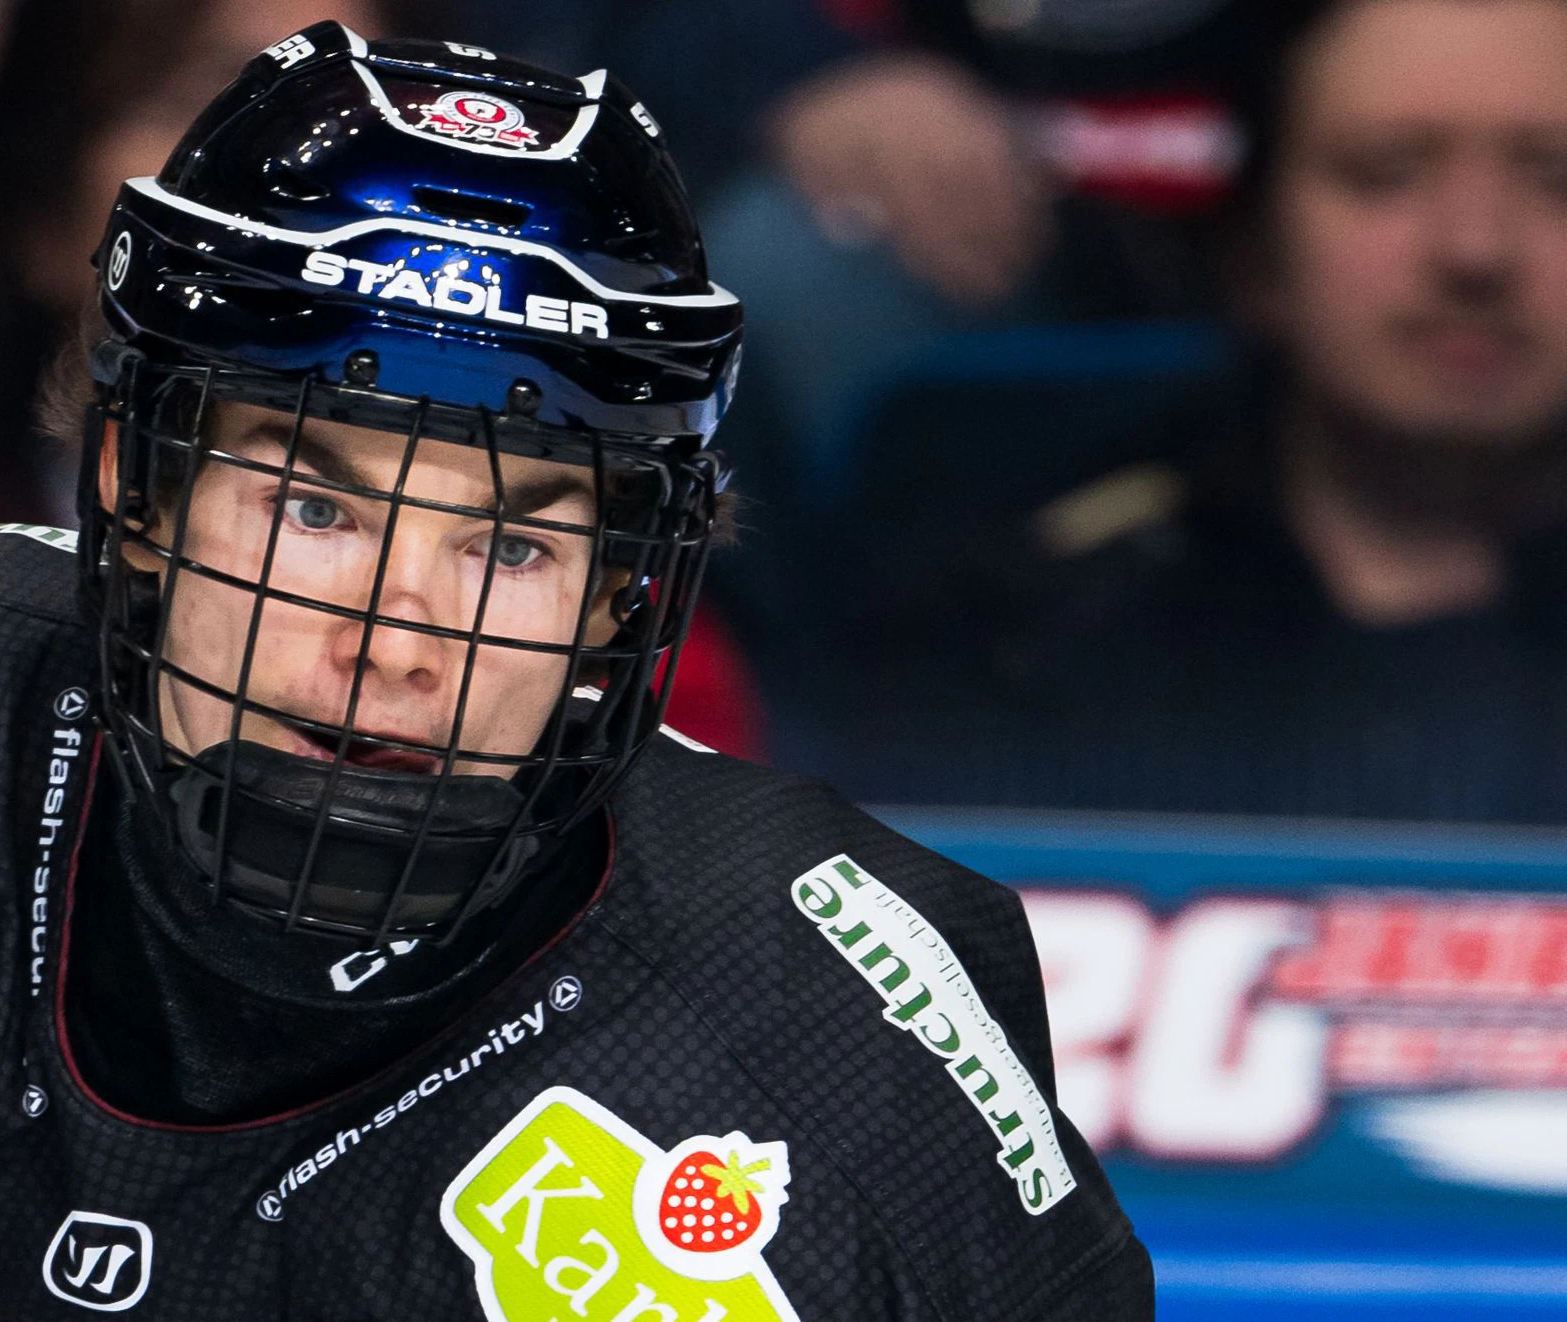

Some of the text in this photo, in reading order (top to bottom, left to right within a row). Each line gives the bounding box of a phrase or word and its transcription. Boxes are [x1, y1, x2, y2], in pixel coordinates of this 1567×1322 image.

[301, 252, 609, 340] STADLER
[279, 1001, 545, 1198] flash-security
[797, 876, 1053, 1209] structure
